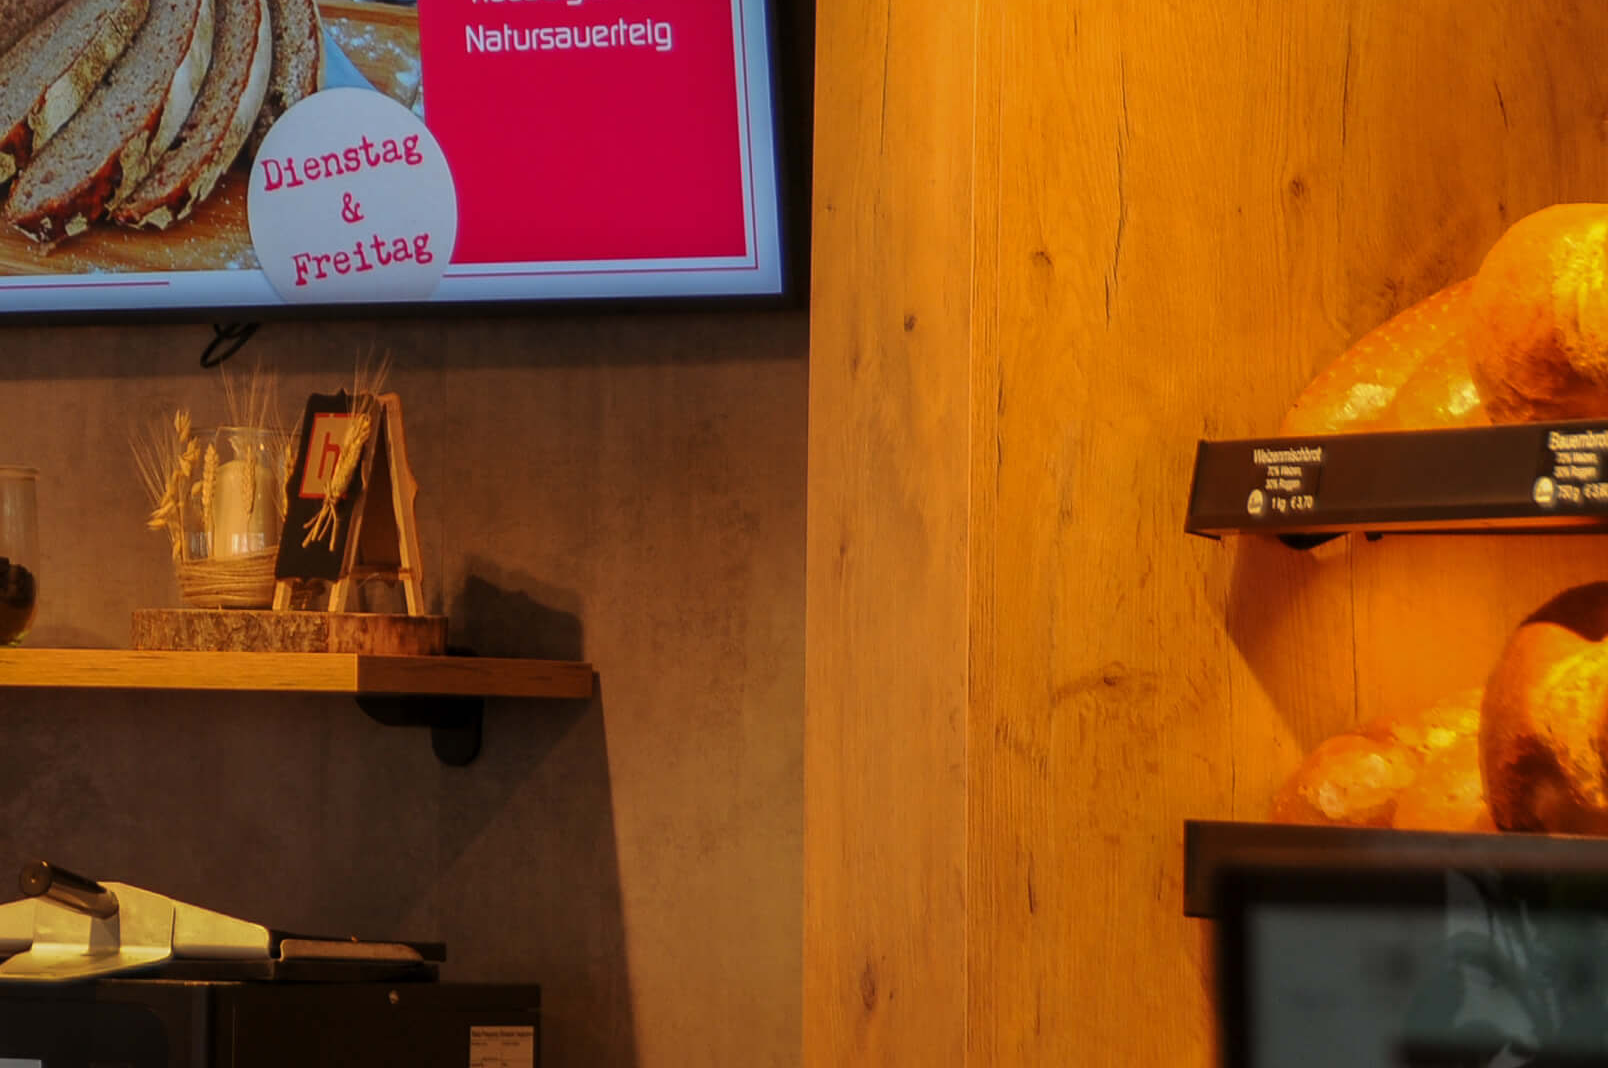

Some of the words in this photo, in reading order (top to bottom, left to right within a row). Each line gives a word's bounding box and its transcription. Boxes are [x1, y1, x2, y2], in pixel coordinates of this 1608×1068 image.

[465, 18, 673, 53] Natursauerteig
[261, 134, 424, 192] Dienstag
[341, 192, 365, 223] &
[293, 233, 434, 286] Freitag
